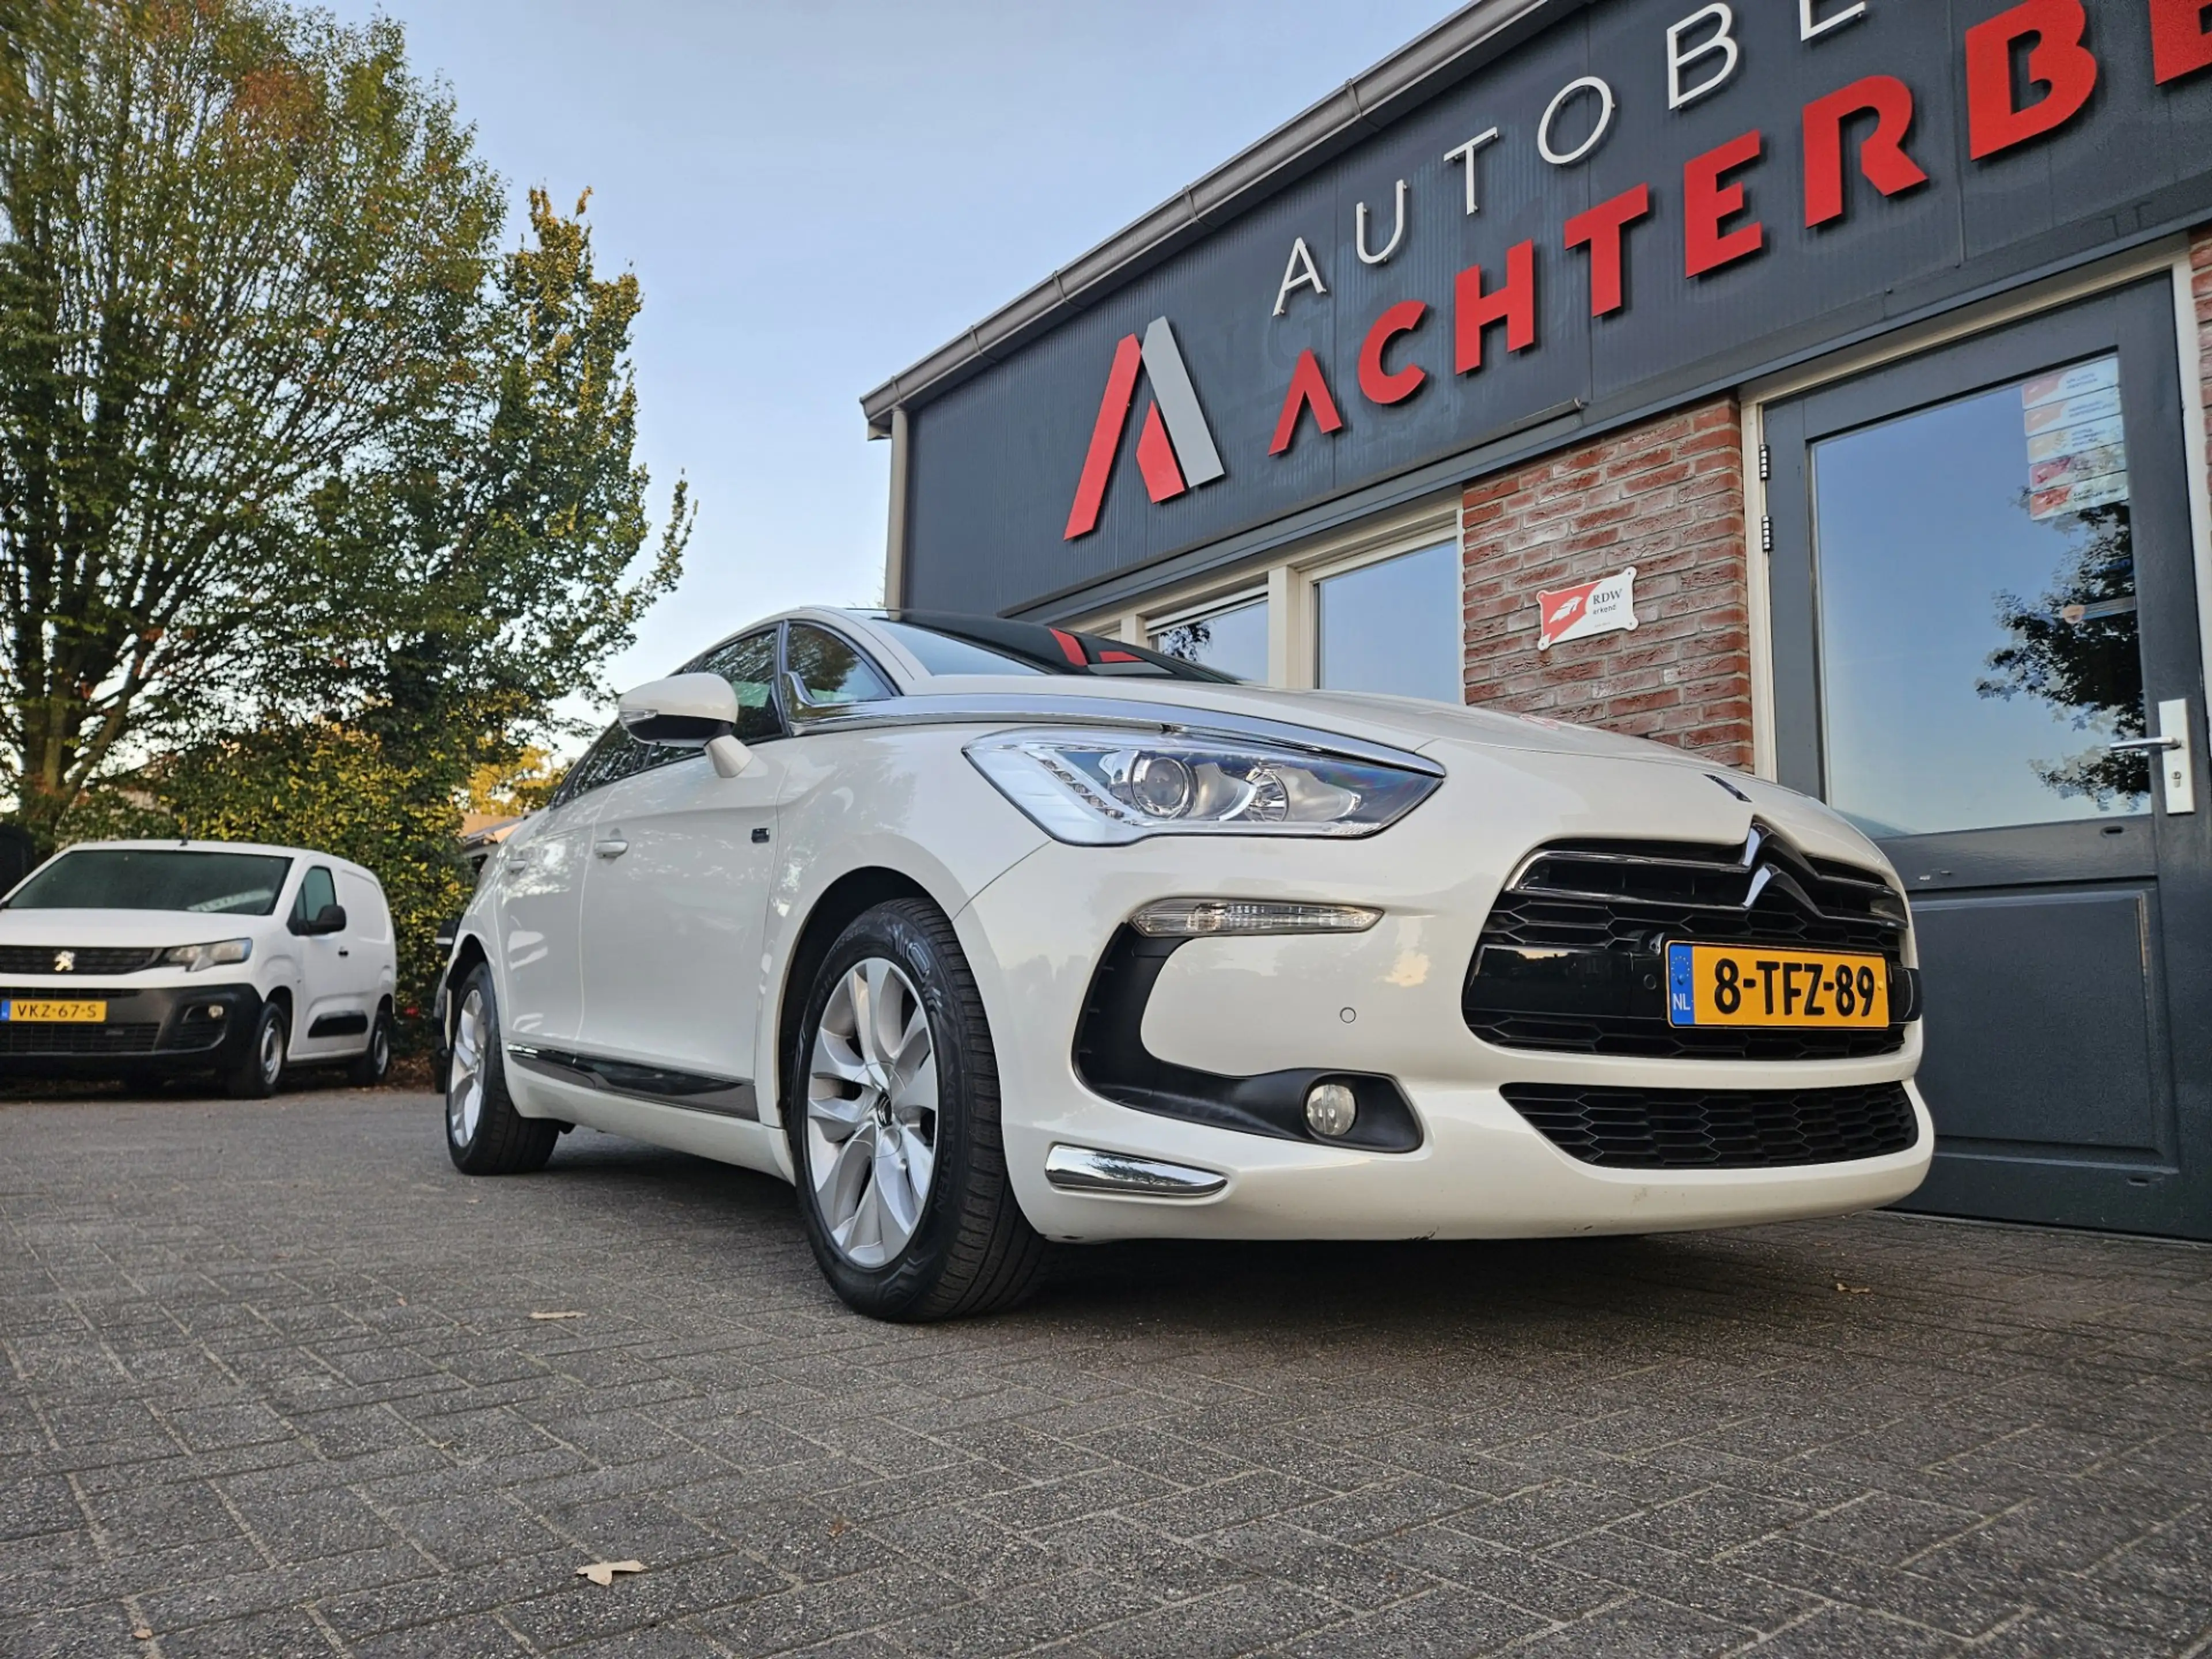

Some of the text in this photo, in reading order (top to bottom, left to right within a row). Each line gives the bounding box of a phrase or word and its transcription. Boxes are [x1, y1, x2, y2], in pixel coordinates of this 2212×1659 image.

[1593, 588, 1623, 605] RDW
[1673, 957, 1875, 1017] NL 8-TFZ-89
[17, 1003, 97, 1018] VKZ-67-S
